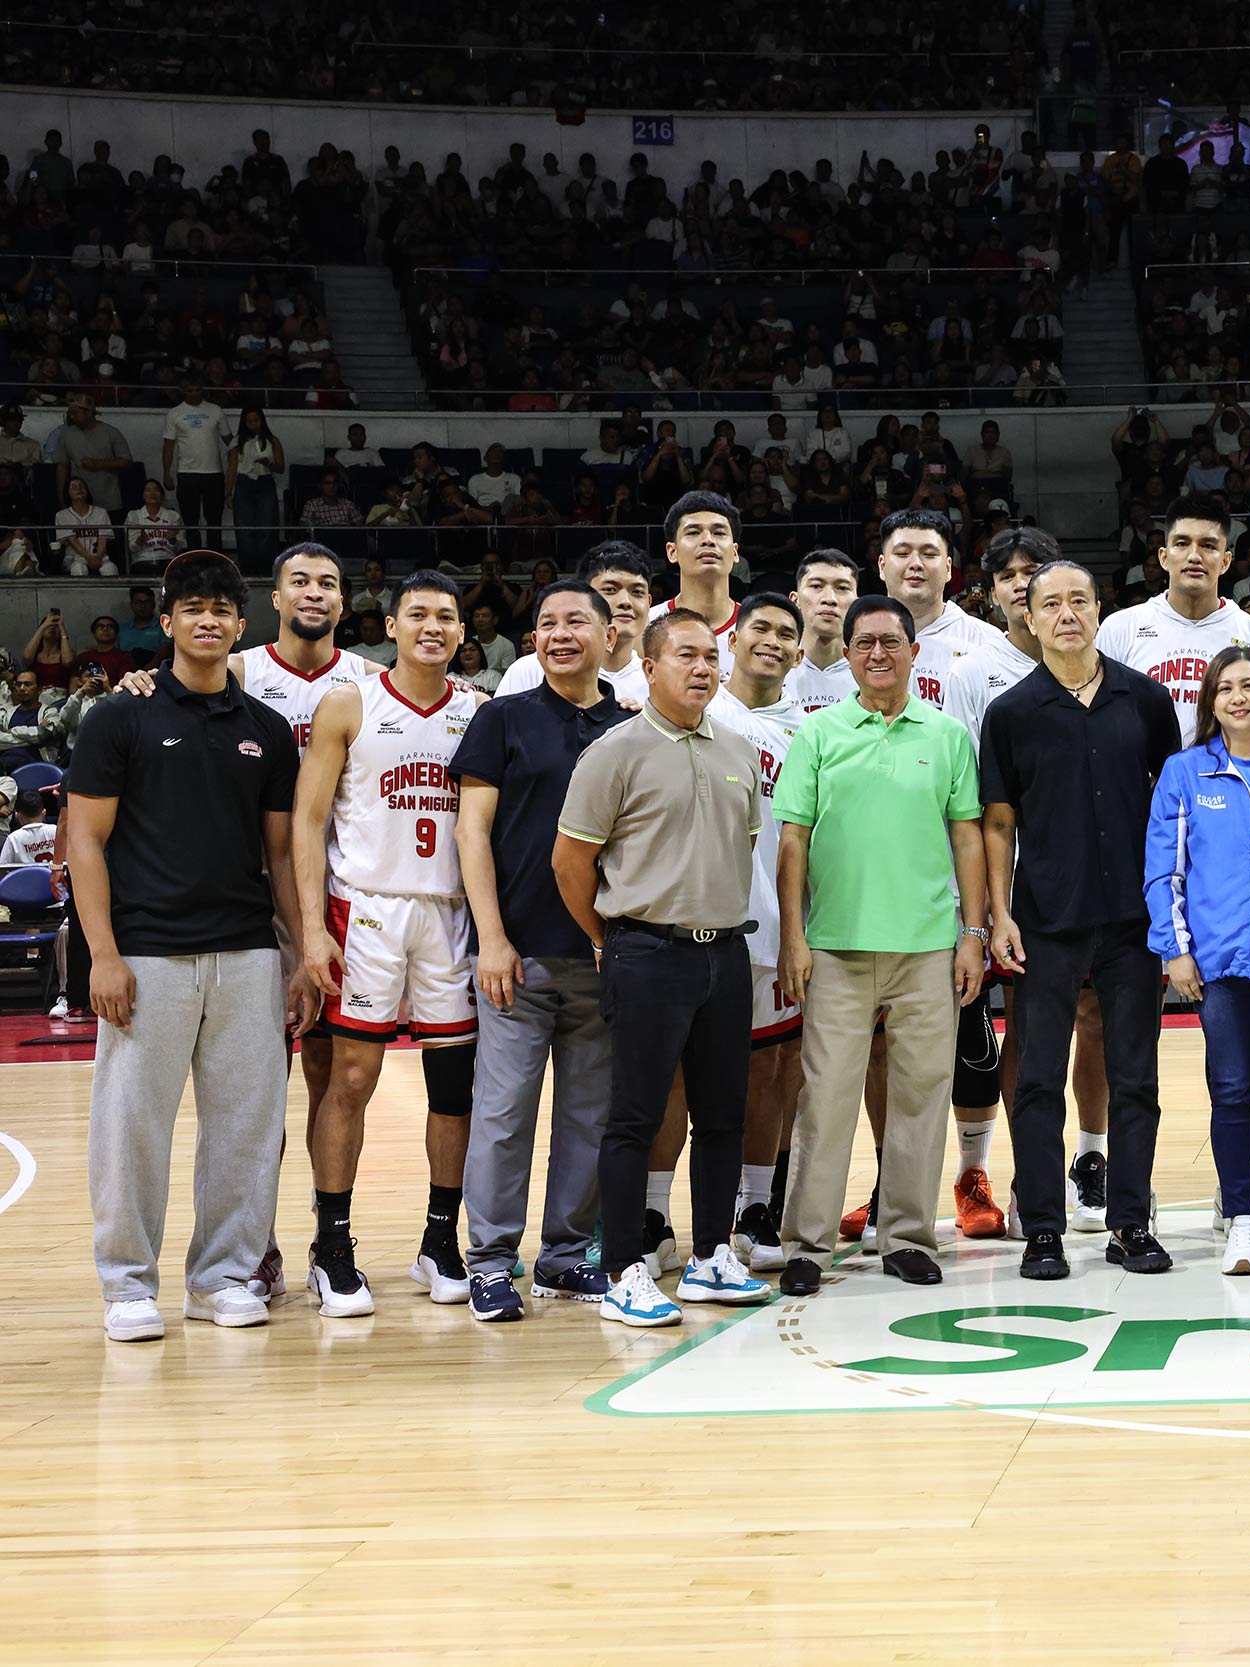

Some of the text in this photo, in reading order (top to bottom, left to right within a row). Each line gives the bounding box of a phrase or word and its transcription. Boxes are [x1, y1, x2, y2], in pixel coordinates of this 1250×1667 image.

[634, 120, 672, 140] 216
[1167, 648, 1214, 658] BARANGA
[1147, 658, 1209, 684] GINEB
[795, 696, 841, 707] BARANGA
[399, 751, 450, 763] BARANGA
[380, 762, 458, 798] GINEBR
[388, 794, 417, 811] SAN
[416, 818, 437, 858] 9
